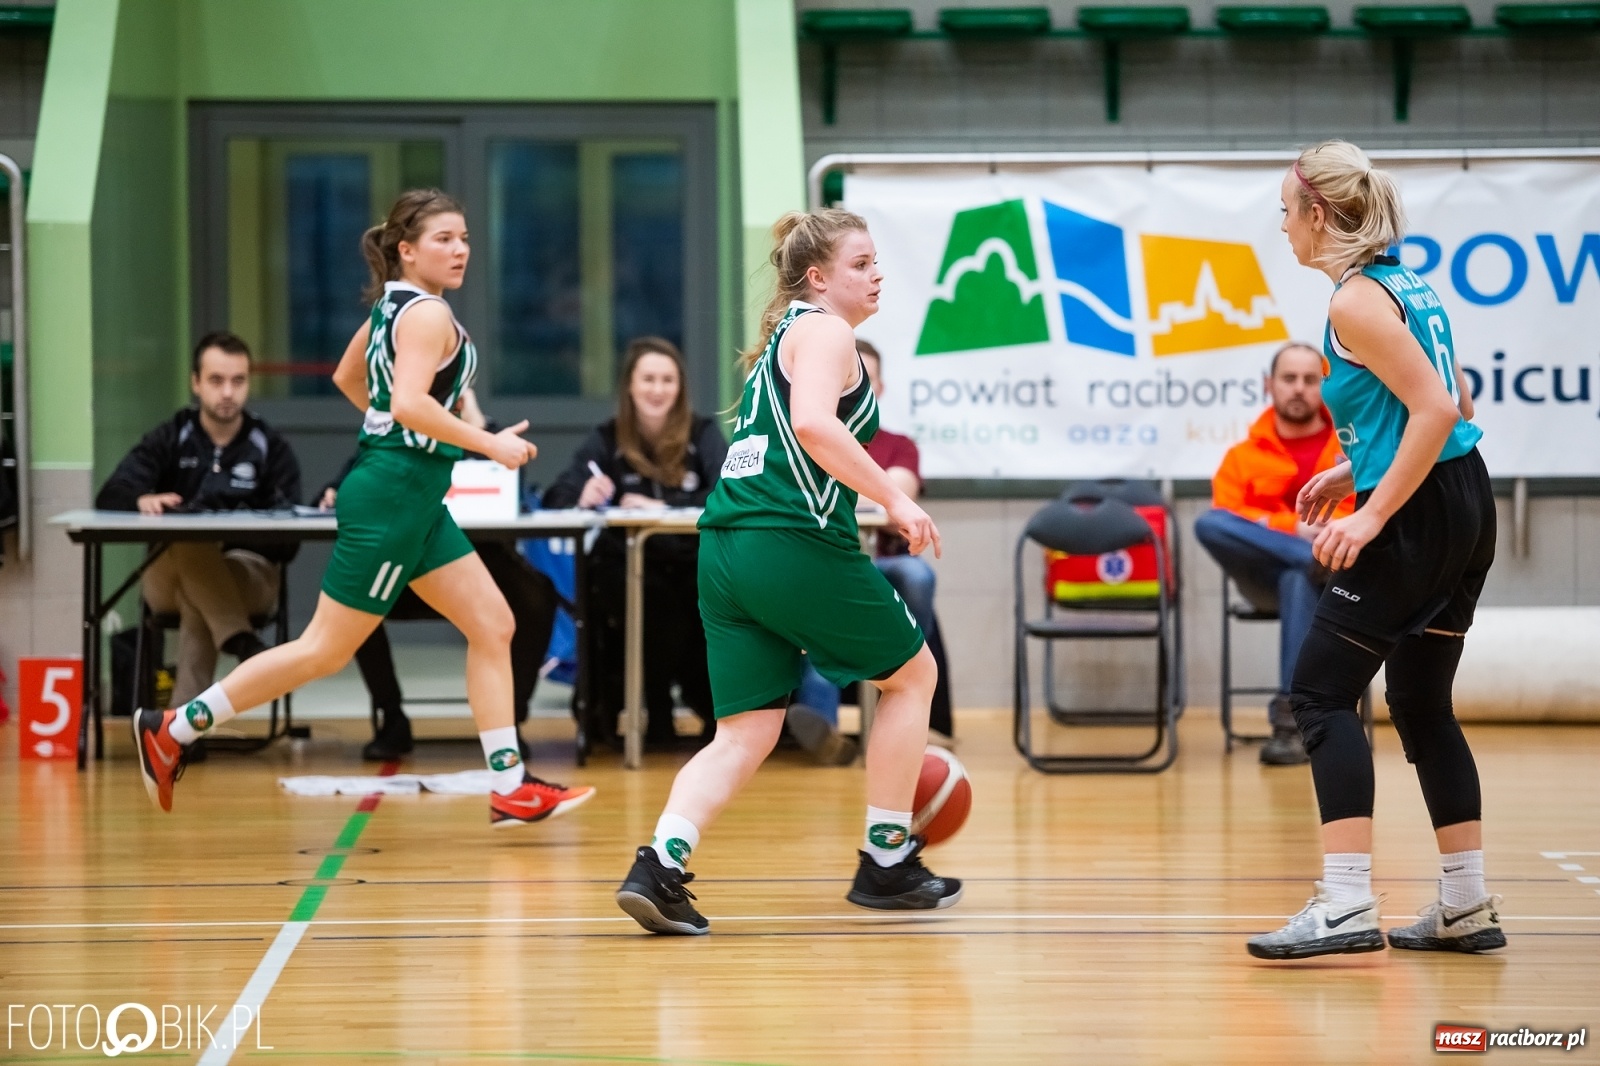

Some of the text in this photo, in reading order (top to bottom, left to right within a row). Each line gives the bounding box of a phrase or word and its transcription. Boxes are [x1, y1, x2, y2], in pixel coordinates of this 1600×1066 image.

[1427, 315, 1460, 408] 6
[909, 369, 1057, 417] powiat
[912, 418, 1040, 446] zielona
[1066, 422, 1159, 446] oaza
[29, 666, 75, 737] 5
